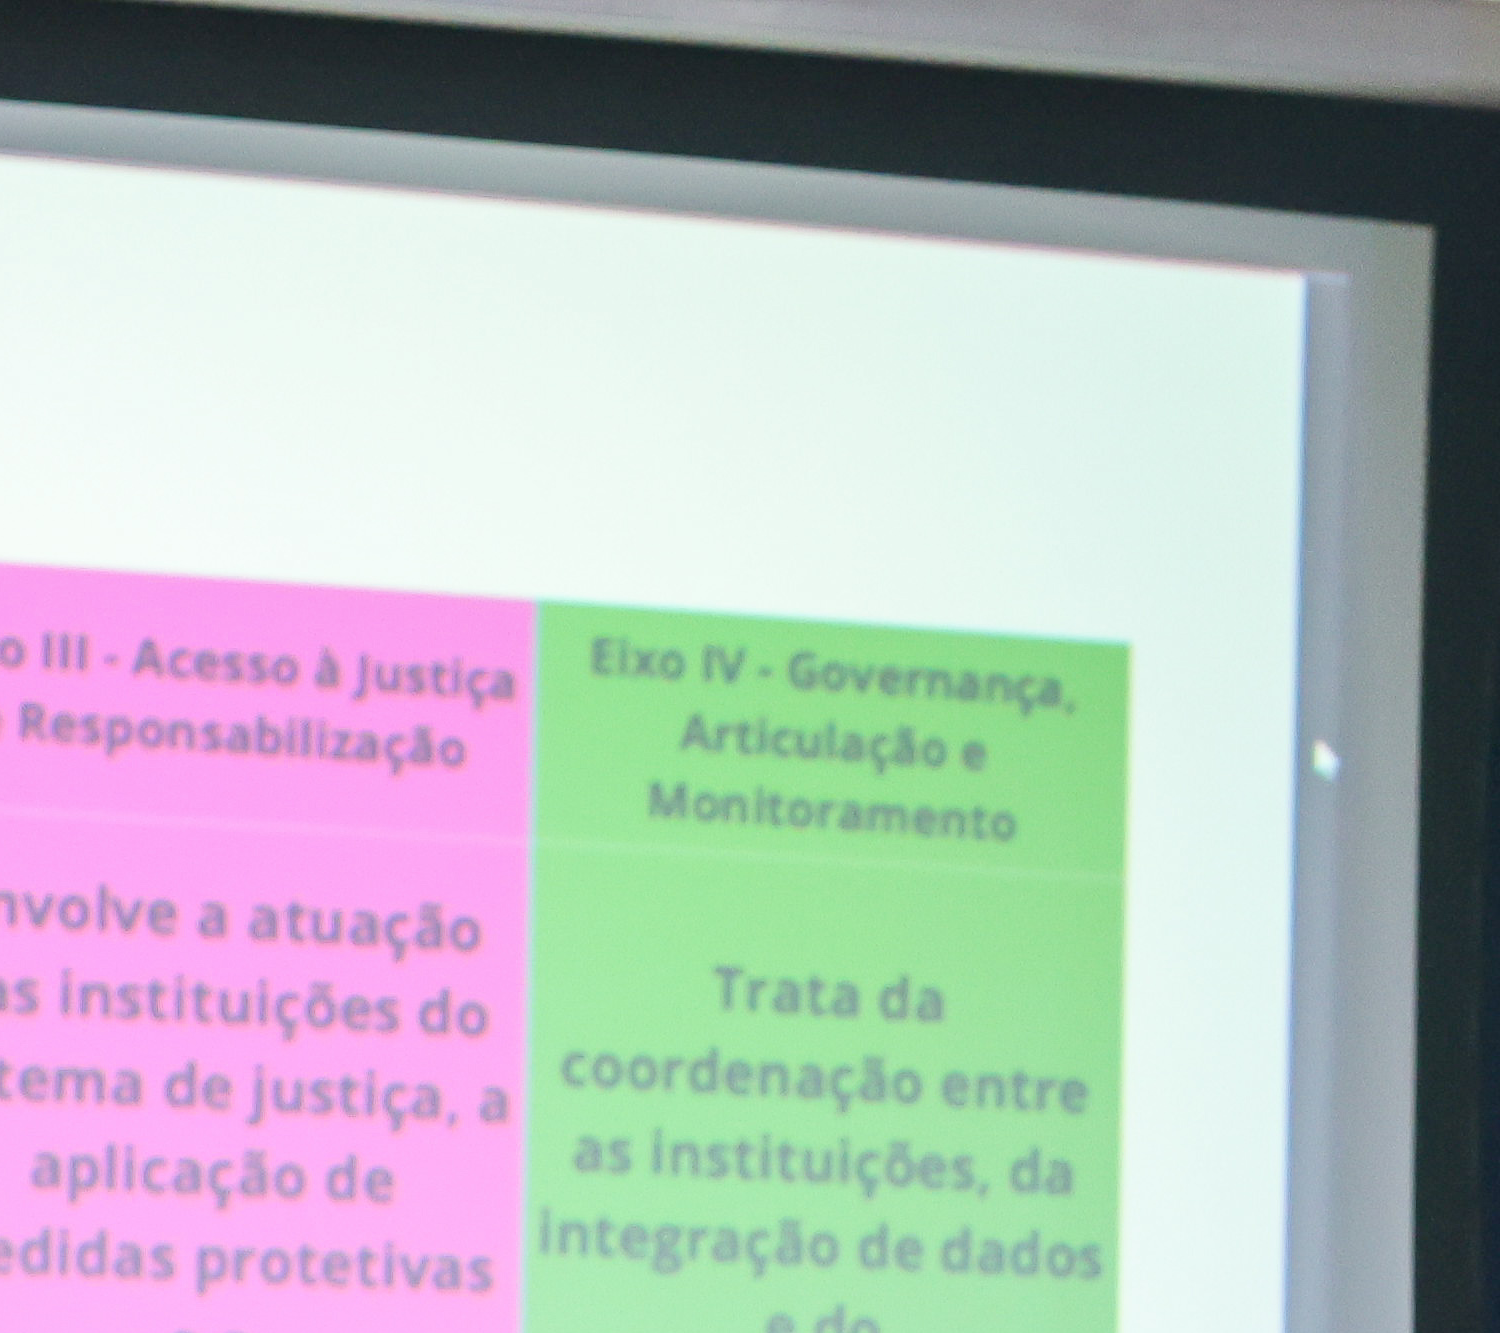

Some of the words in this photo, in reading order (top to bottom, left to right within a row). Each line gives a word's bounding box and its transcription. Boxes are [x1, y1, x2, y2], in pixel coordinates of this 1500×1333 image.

[42, 632, 89, 672] III
[132, 638, 300, 686] Acesso
[314, 648, 342, 689] à
[354, 645, 516, 706] Justiça
[590, 634, 687, 681] Eixo
[702, 644, 747, 684] IV
[787, 649, 1075, 717] Governança,
[19, 702, 467, 772] Responsabilização
[679, 712, 948, 776] Articulação
[961, 740, 987, 771] e
[647, 779, 1018, 843] Monitoramento
[197, 901, 229, 939] a
[248, 901, 482, 961] atuação
[60, 967, 401, 1041] instituições
[418, 989, 490, 1039] do
[712, 964, 861, 1018] Trata
[878, 974, 945, 1023] da
[164, 1061, 233, 1111] de
[248, 1067, 458, 1133] justiça,
[480, 1086, 510, 1124] a
[559, 1046, 924, 1111] coordenação
[940, 1070, 1090, 1115] entre
[30, 1145, 307, 1212] aplicação
[325, 1155, 395, 1205] de
[572, 1133, 634, 1175] as
[652, 1130, 991, 1200] instituições,
[1009, 1147, 1074, 1196] da
[196, 1243, 494, 1296] protetivas
[540, 1207, 840, 1276] integração
[857, 1223, 925, 1273] de
[940, 1228, 1104, 1282] dados
